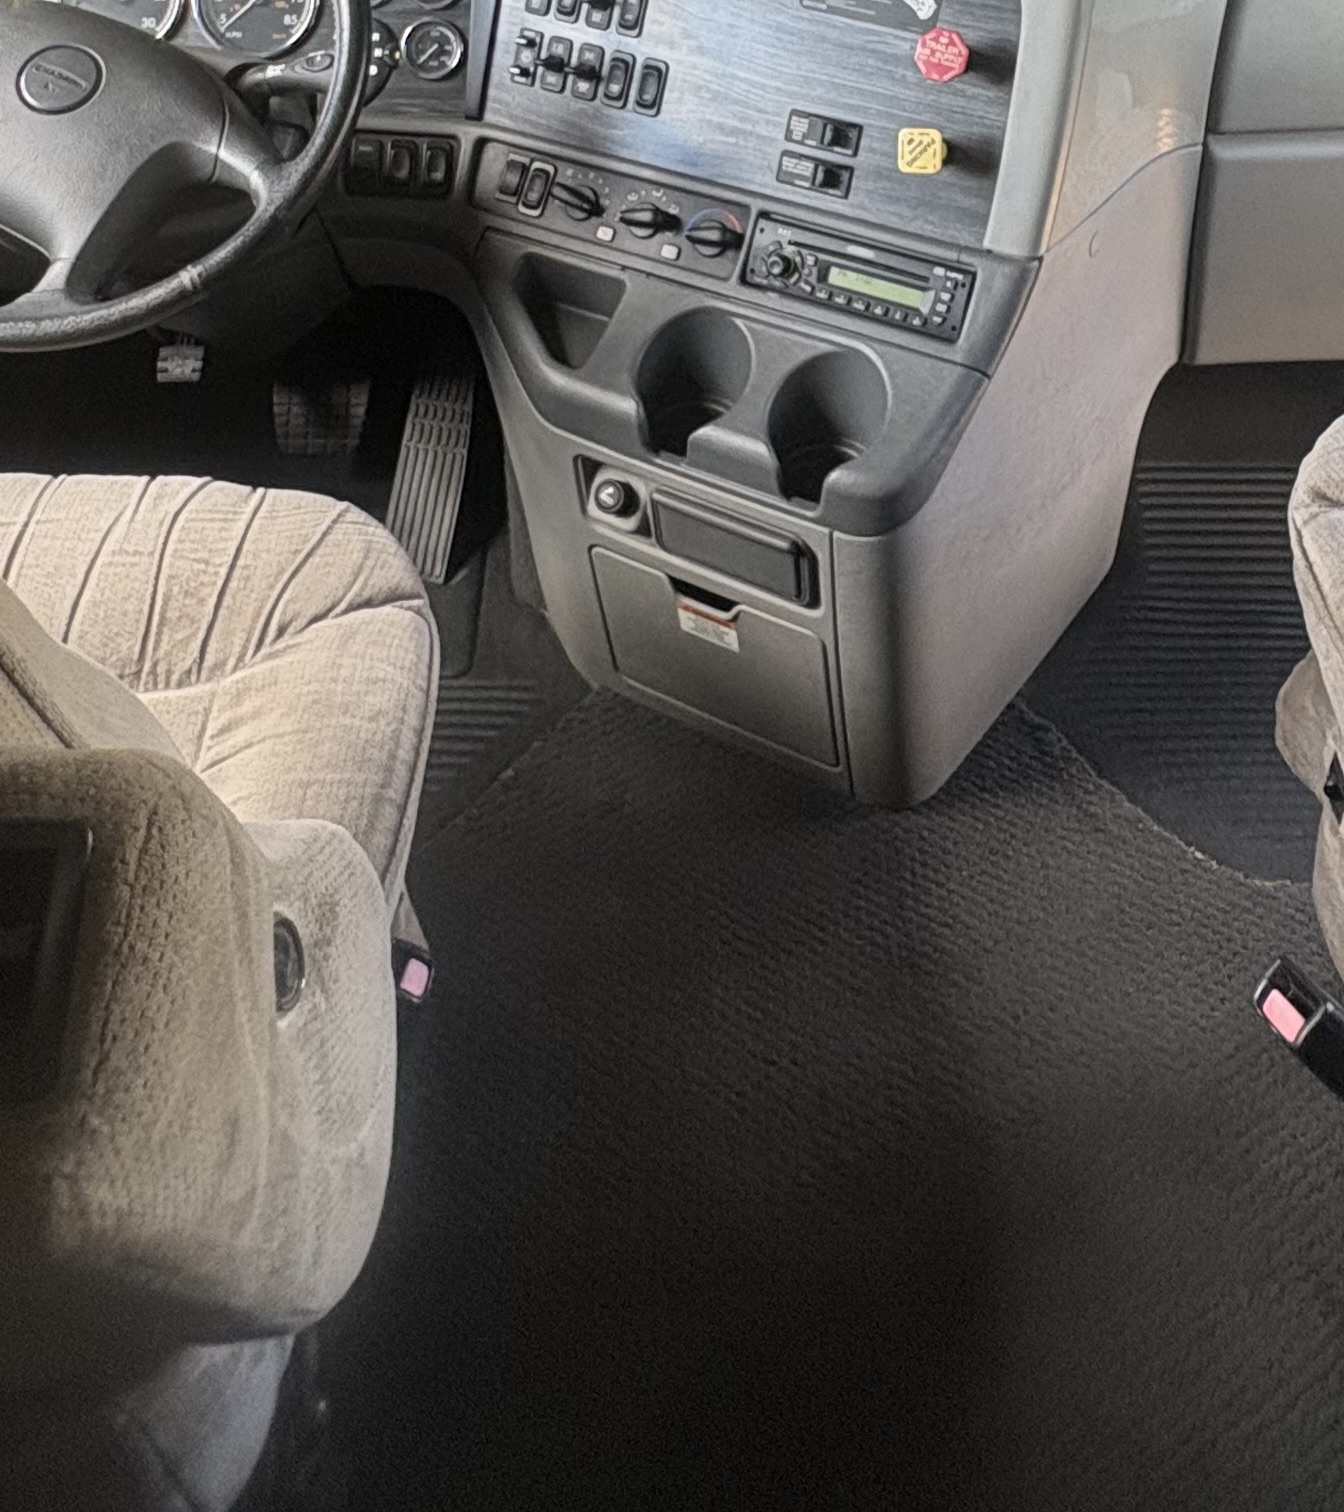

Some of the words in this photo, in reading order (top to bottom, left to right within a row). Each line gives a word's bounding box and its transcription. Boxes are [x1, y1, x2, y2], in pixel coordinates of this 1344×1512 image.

[141, 16, 157, 28] 30
[220, 13, 227, 24] 5
[283, 14, 298, 25] 85
[926, 40, 960, 56] TRAILER
[905, 137, 936, 168] PARKING
